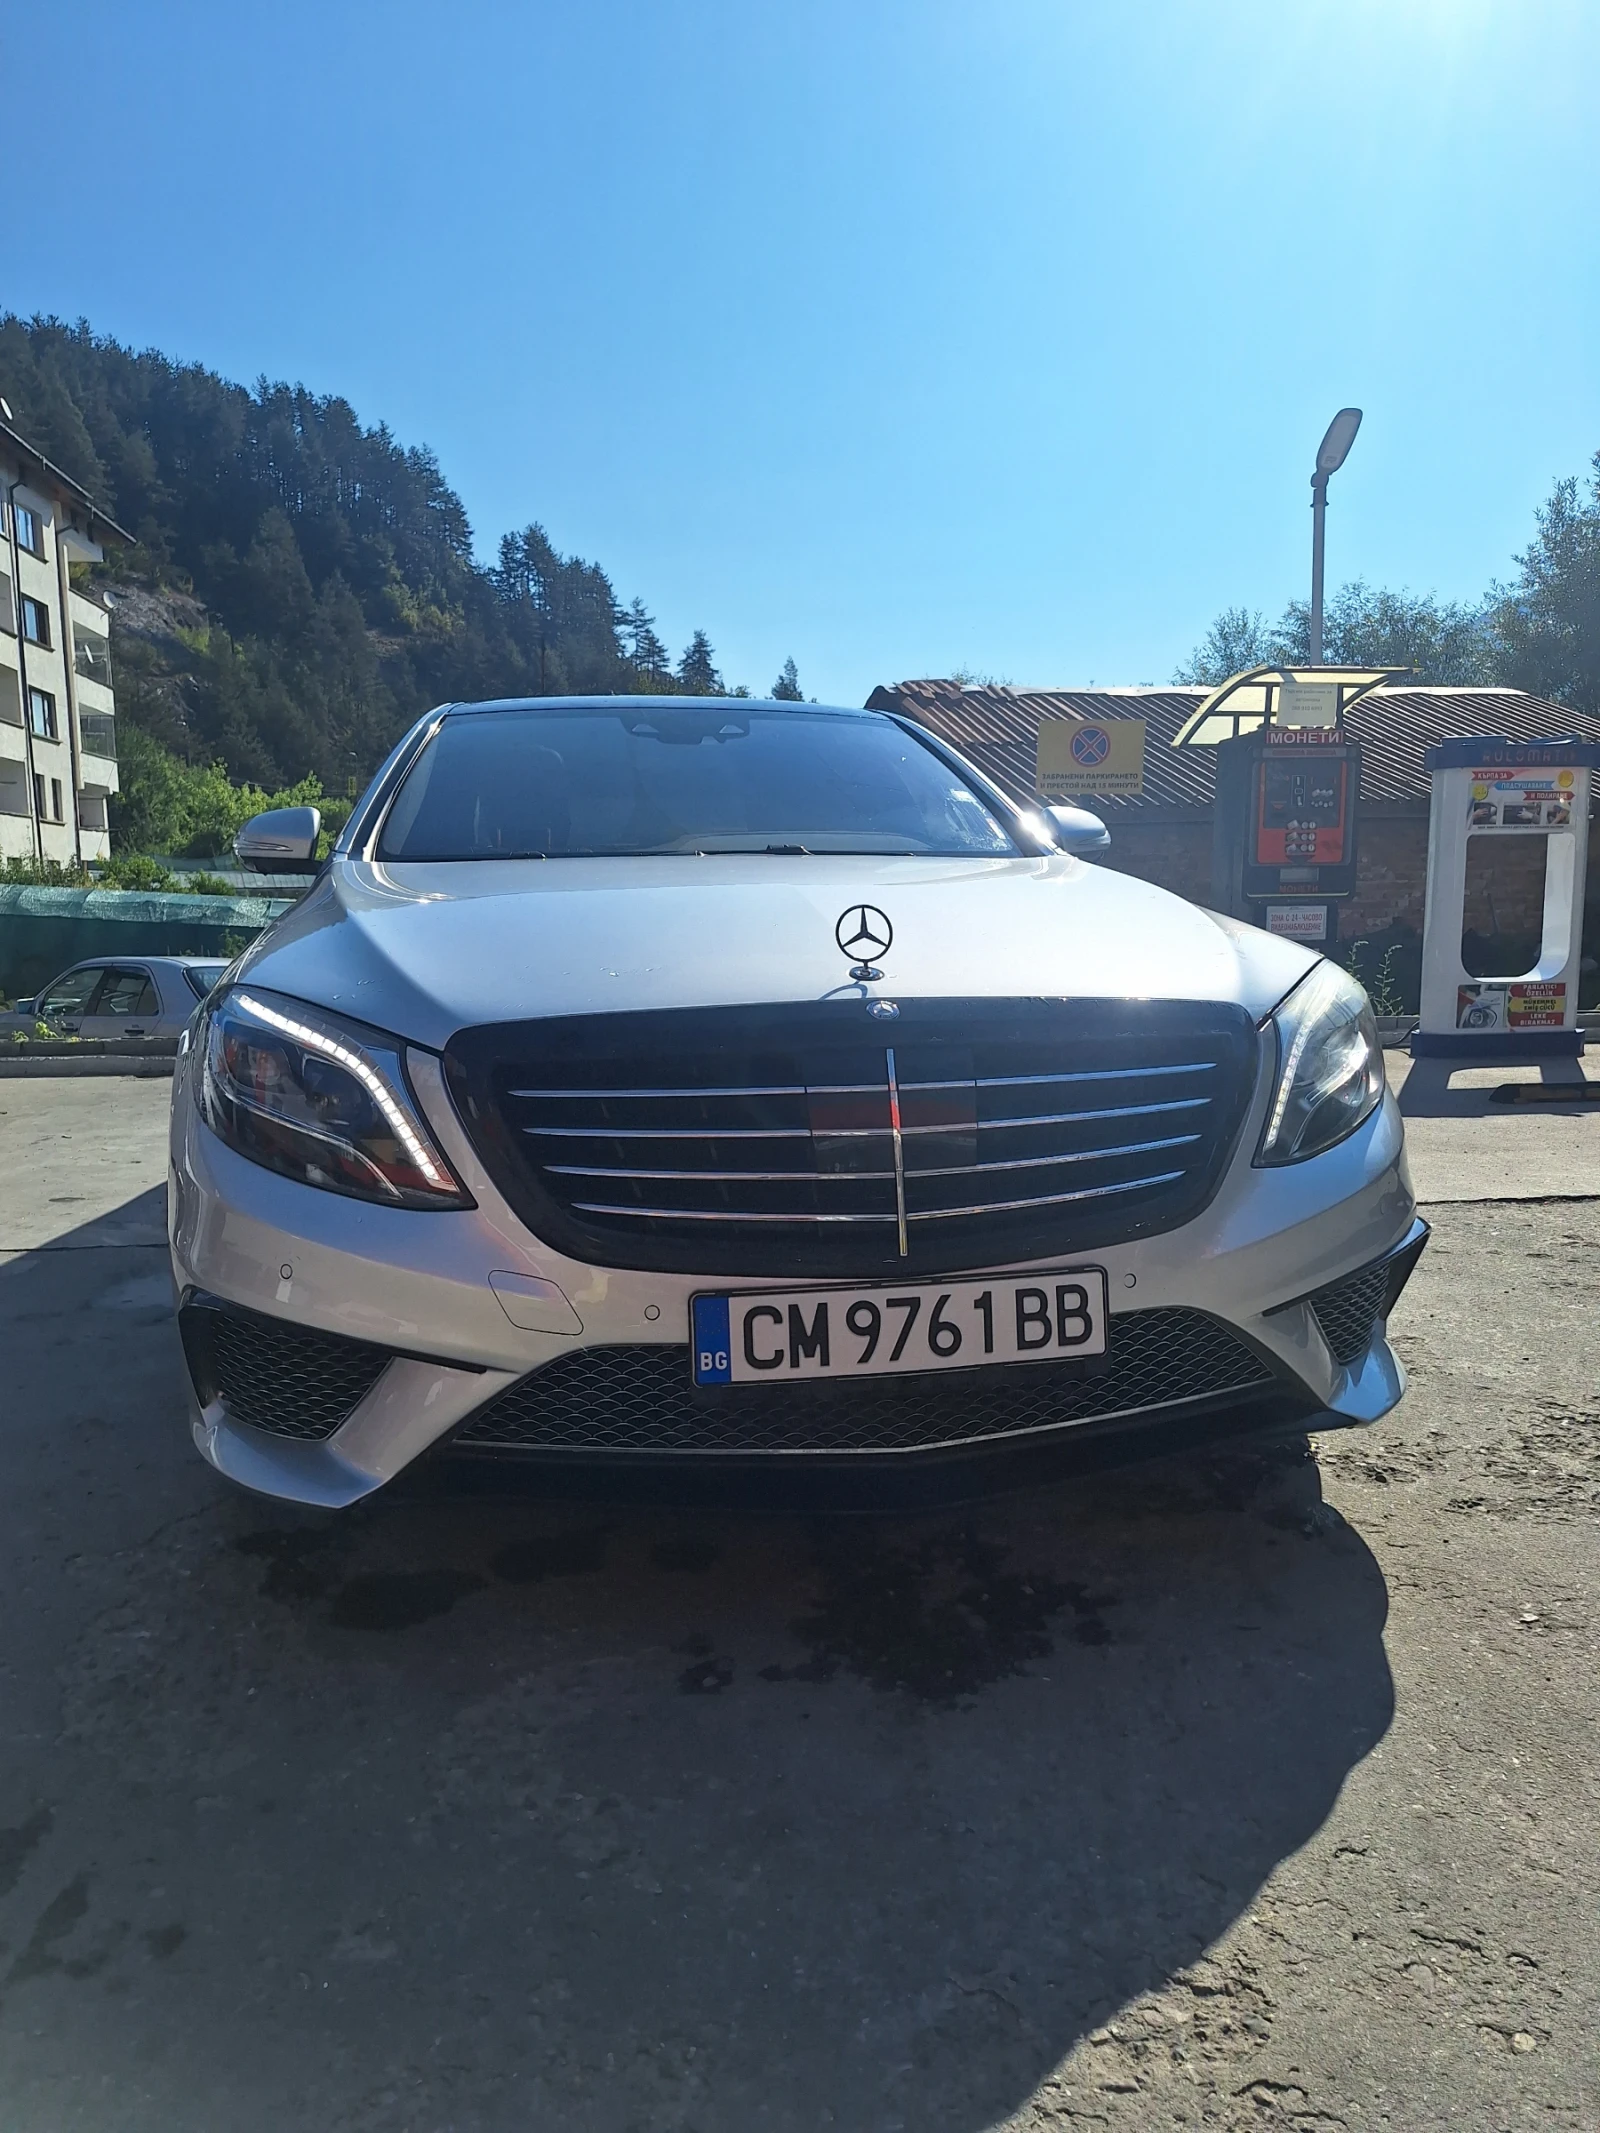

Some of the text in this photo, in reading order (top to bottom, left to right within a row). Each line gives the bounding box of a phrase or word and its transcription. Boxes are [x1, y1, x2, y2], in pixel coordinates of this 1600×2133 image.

[1270, 732, 1339, 744] МОНЕТИ
[1270, 914, 1284, 922] ЗОНА
[846, 1290, 994, 1364] 9761
[699, 1350, 728, 1371] BG
